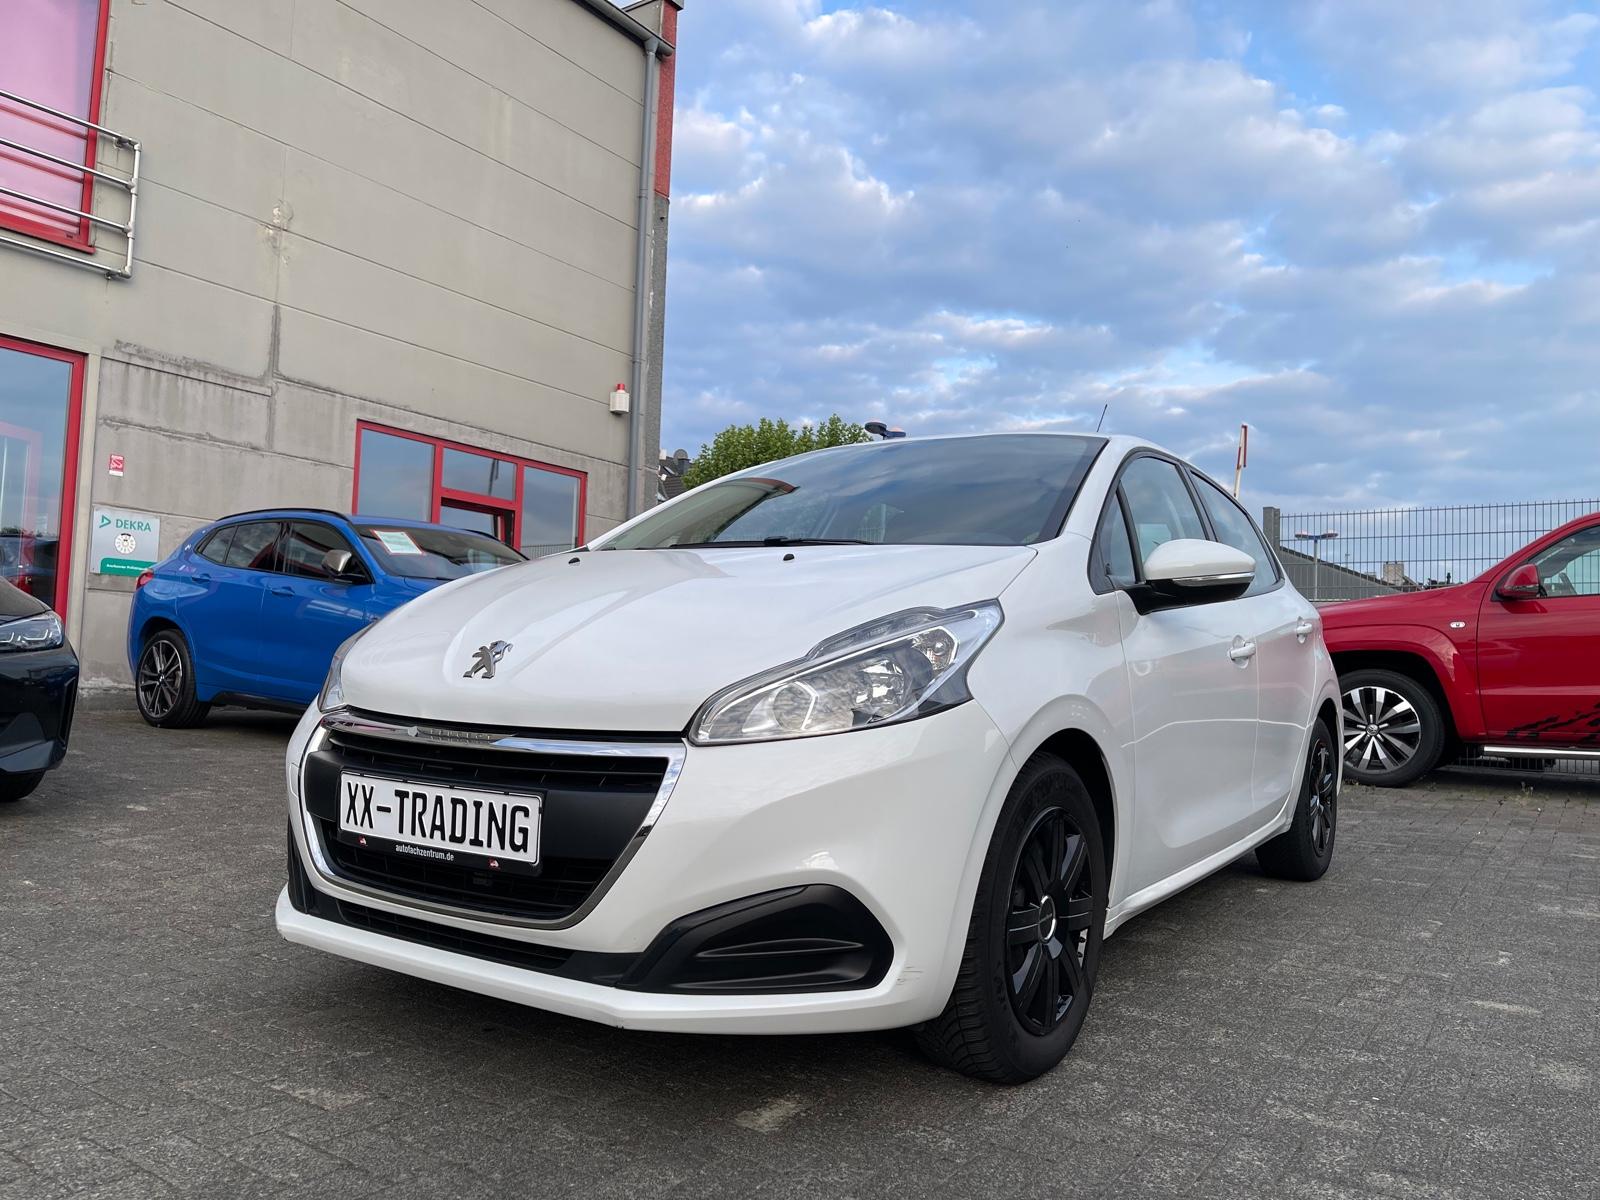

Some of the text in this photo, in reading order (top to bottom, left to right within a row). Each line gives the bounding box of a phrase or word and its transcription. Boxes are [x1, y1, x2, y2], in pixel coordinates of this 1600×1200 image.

[116, 518, 152, 532] DEKRA
[346, 782, 530, 854] XX-TRADING
[395, 843, 455, 861] autofachzentrum.de
